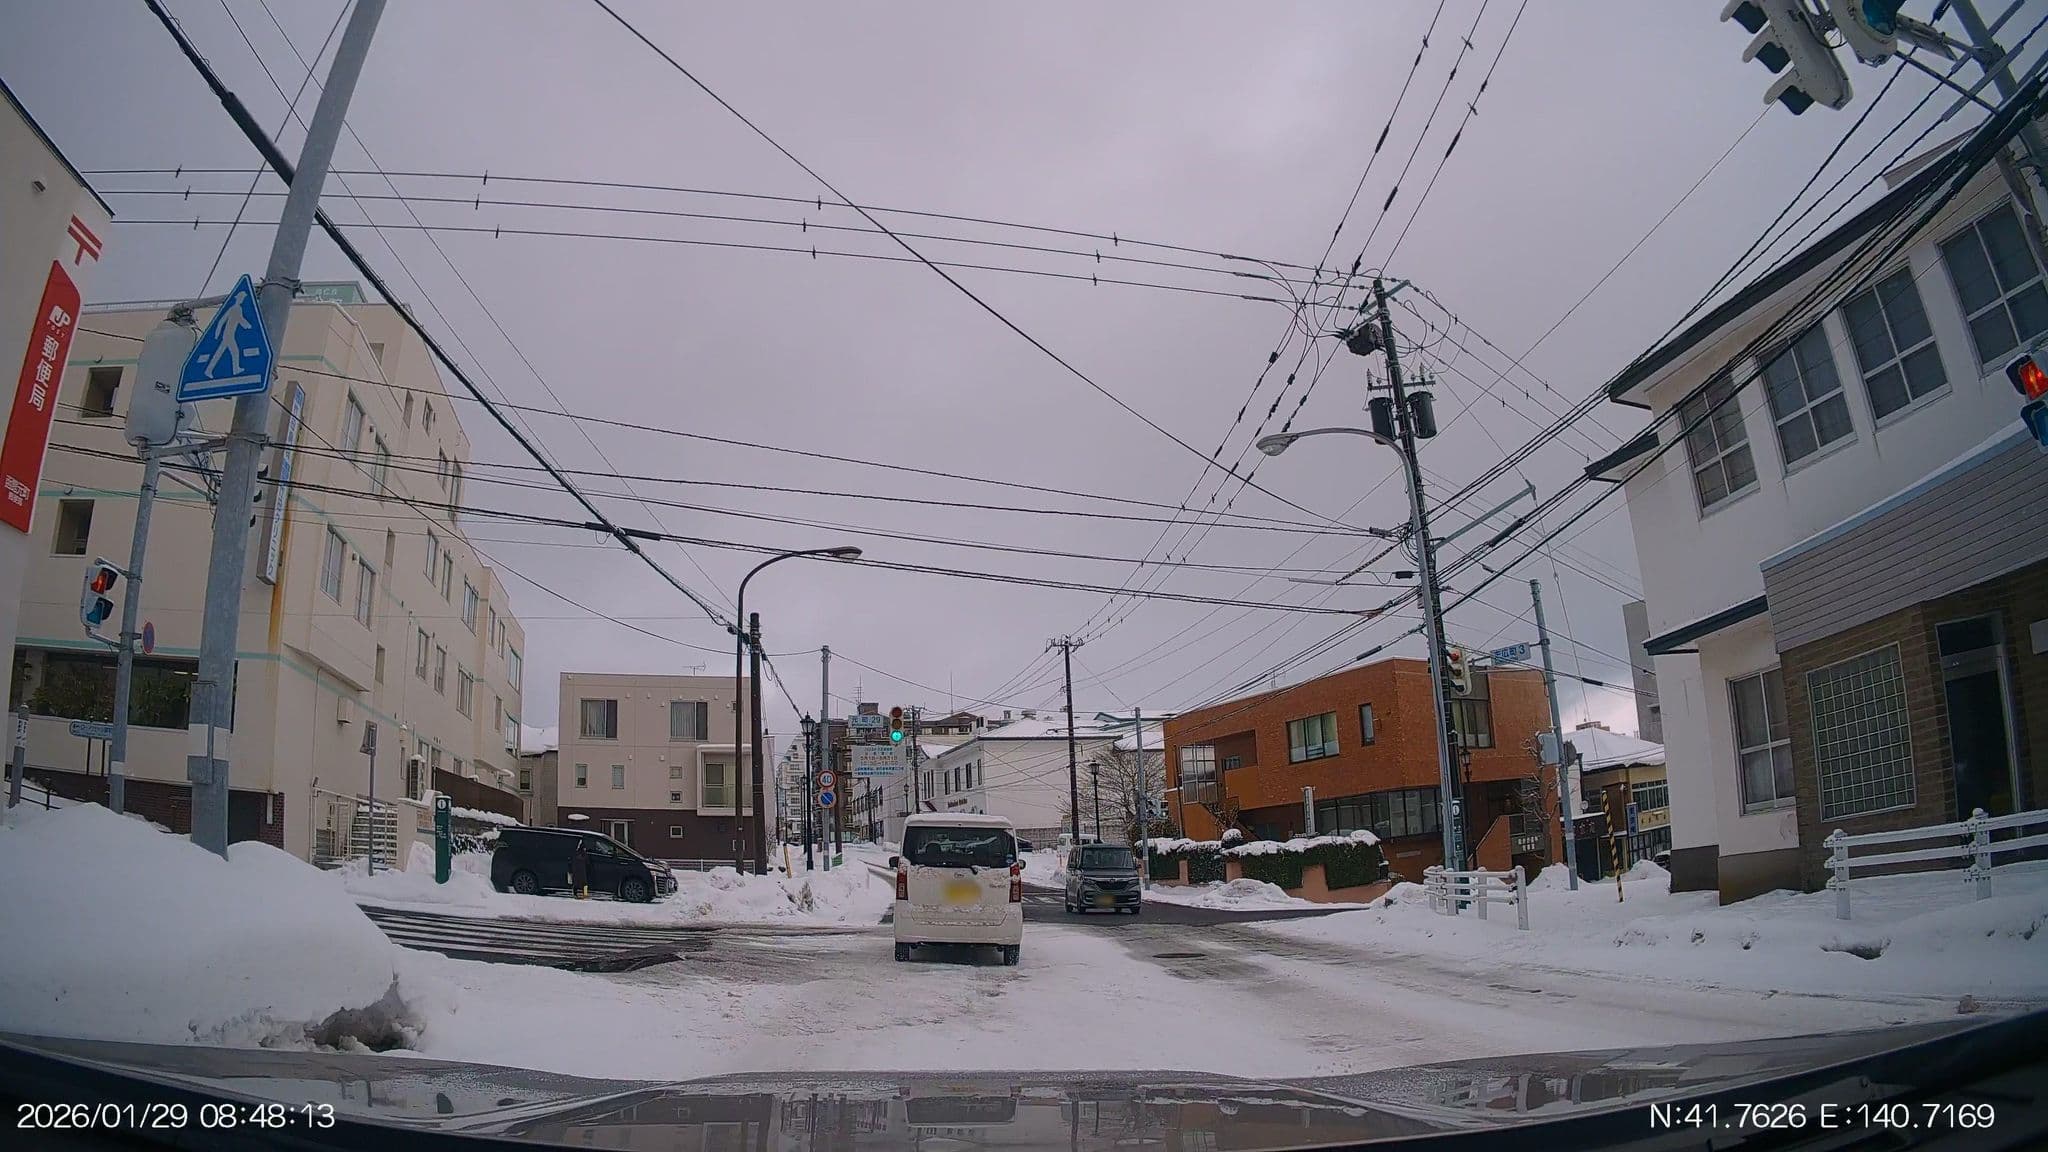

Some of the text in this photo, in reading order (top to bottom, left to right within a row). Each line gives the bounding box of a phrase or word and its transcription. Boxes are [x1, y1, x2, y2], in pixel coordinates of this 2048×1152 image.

[28, 335, 60, 412] 郵便局
[1519, 644, 1526, 655] 3
[871, 715, 881, 724] 29
[822, 775, 832, 784] 40
